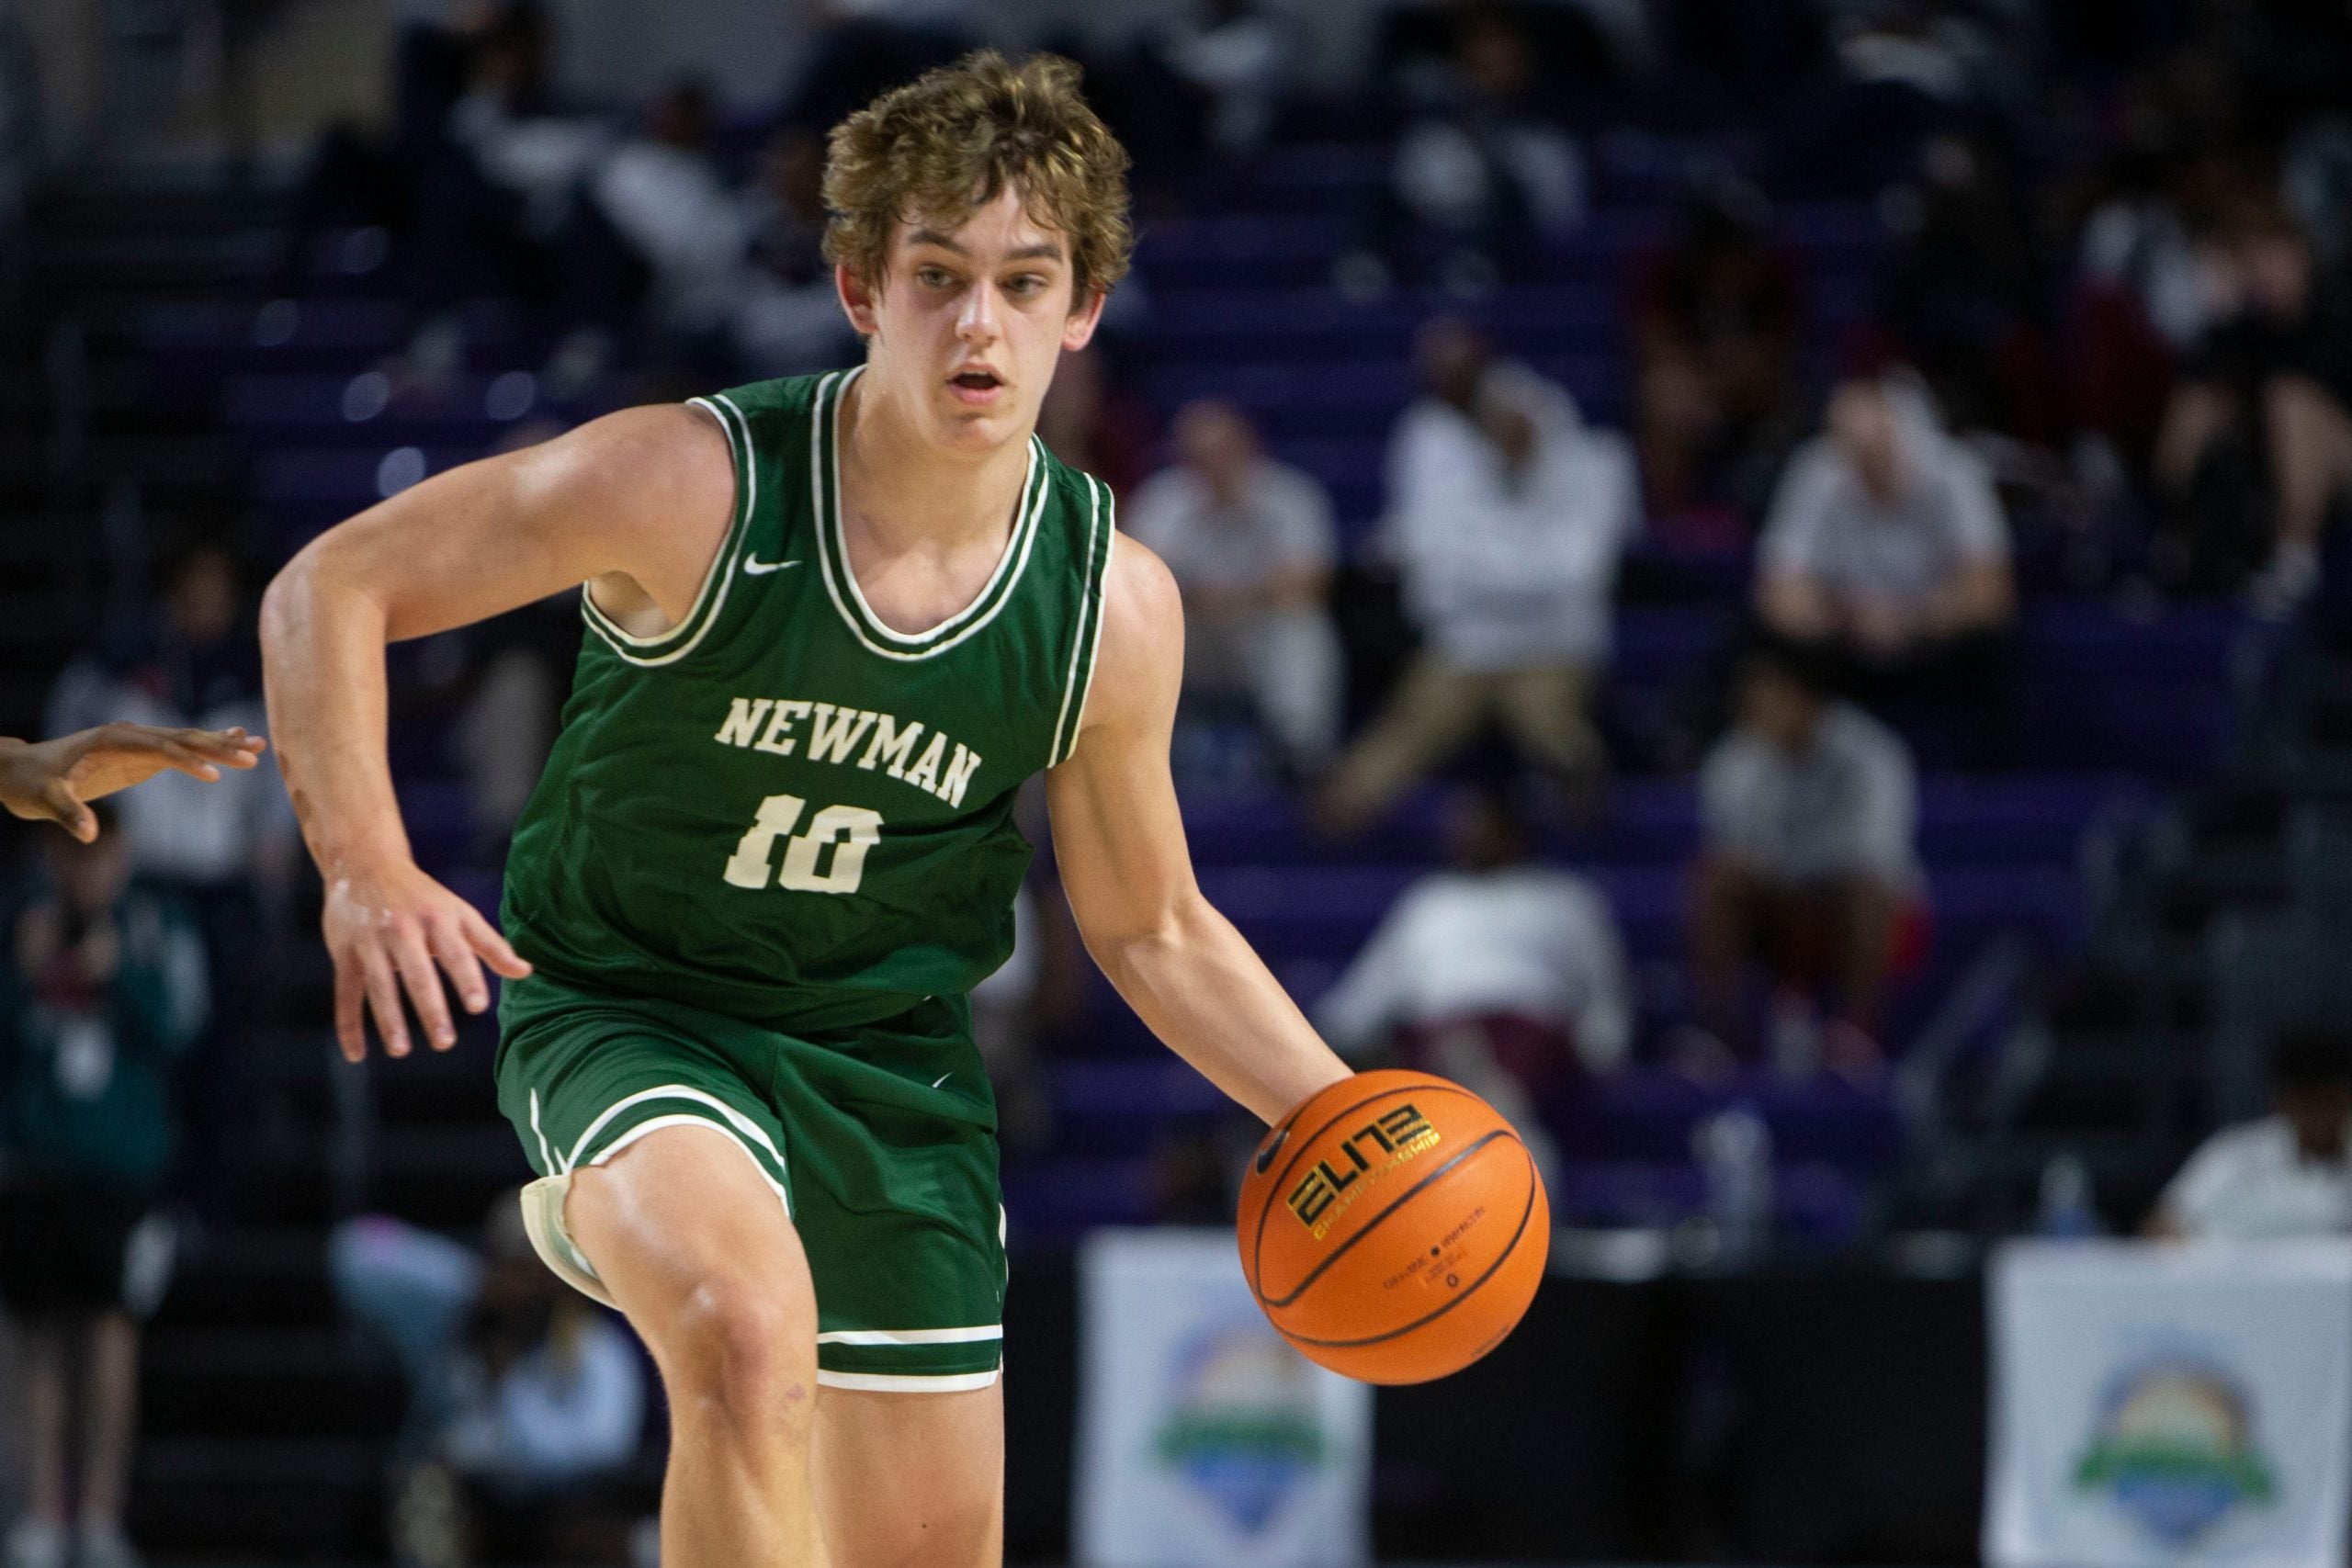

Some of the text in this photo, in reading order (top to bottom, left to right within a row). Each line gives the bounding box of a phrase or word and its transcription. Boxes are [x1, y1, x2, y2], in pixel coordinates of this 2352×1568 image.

[714, 697, 982, 809] NEWMAN
[723, 794, 885, 894] 10
[1288, 1104, 1435, 1229] ELITE
